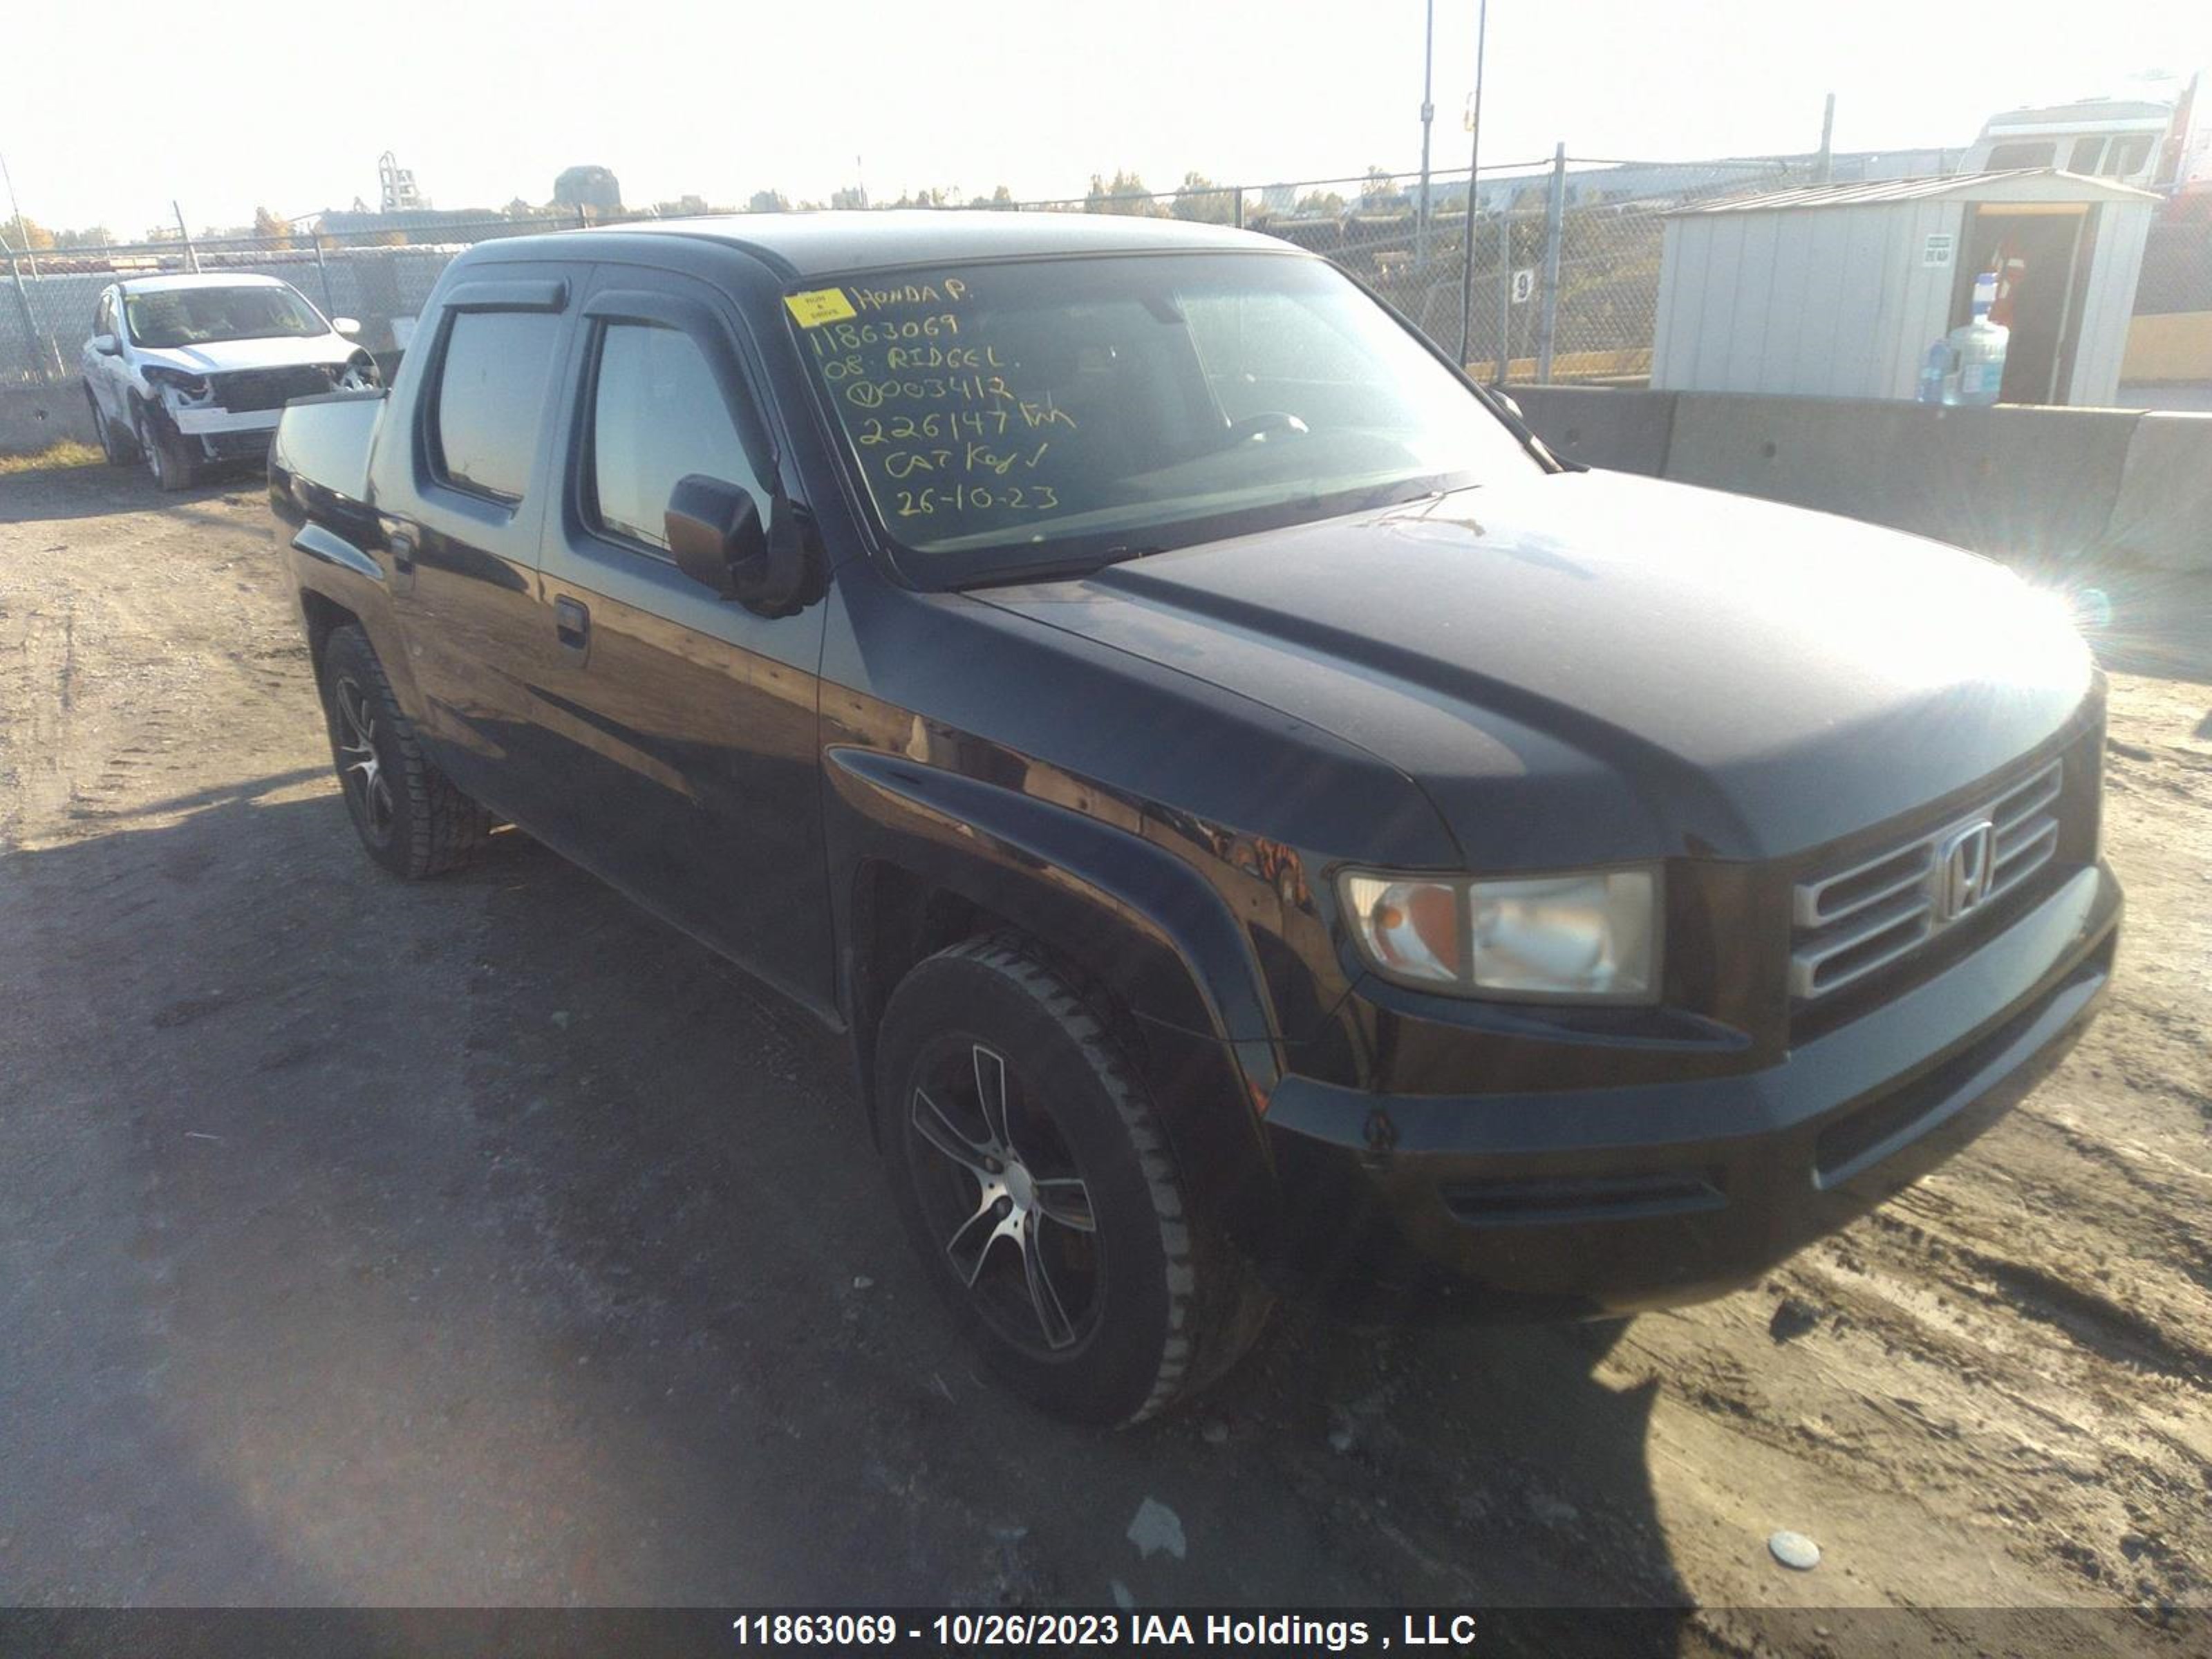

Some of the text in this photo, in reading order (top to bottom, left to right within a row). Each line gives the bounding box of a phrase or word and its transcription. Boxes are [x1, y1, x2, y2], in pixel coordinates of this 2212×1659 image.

[850, 286, 941, 310] HONDA
[810, 314, 958, 355] 11863069
[859, 411, 1007, 444] 226147
[897, 484, 1059, 516] 26-10-23
